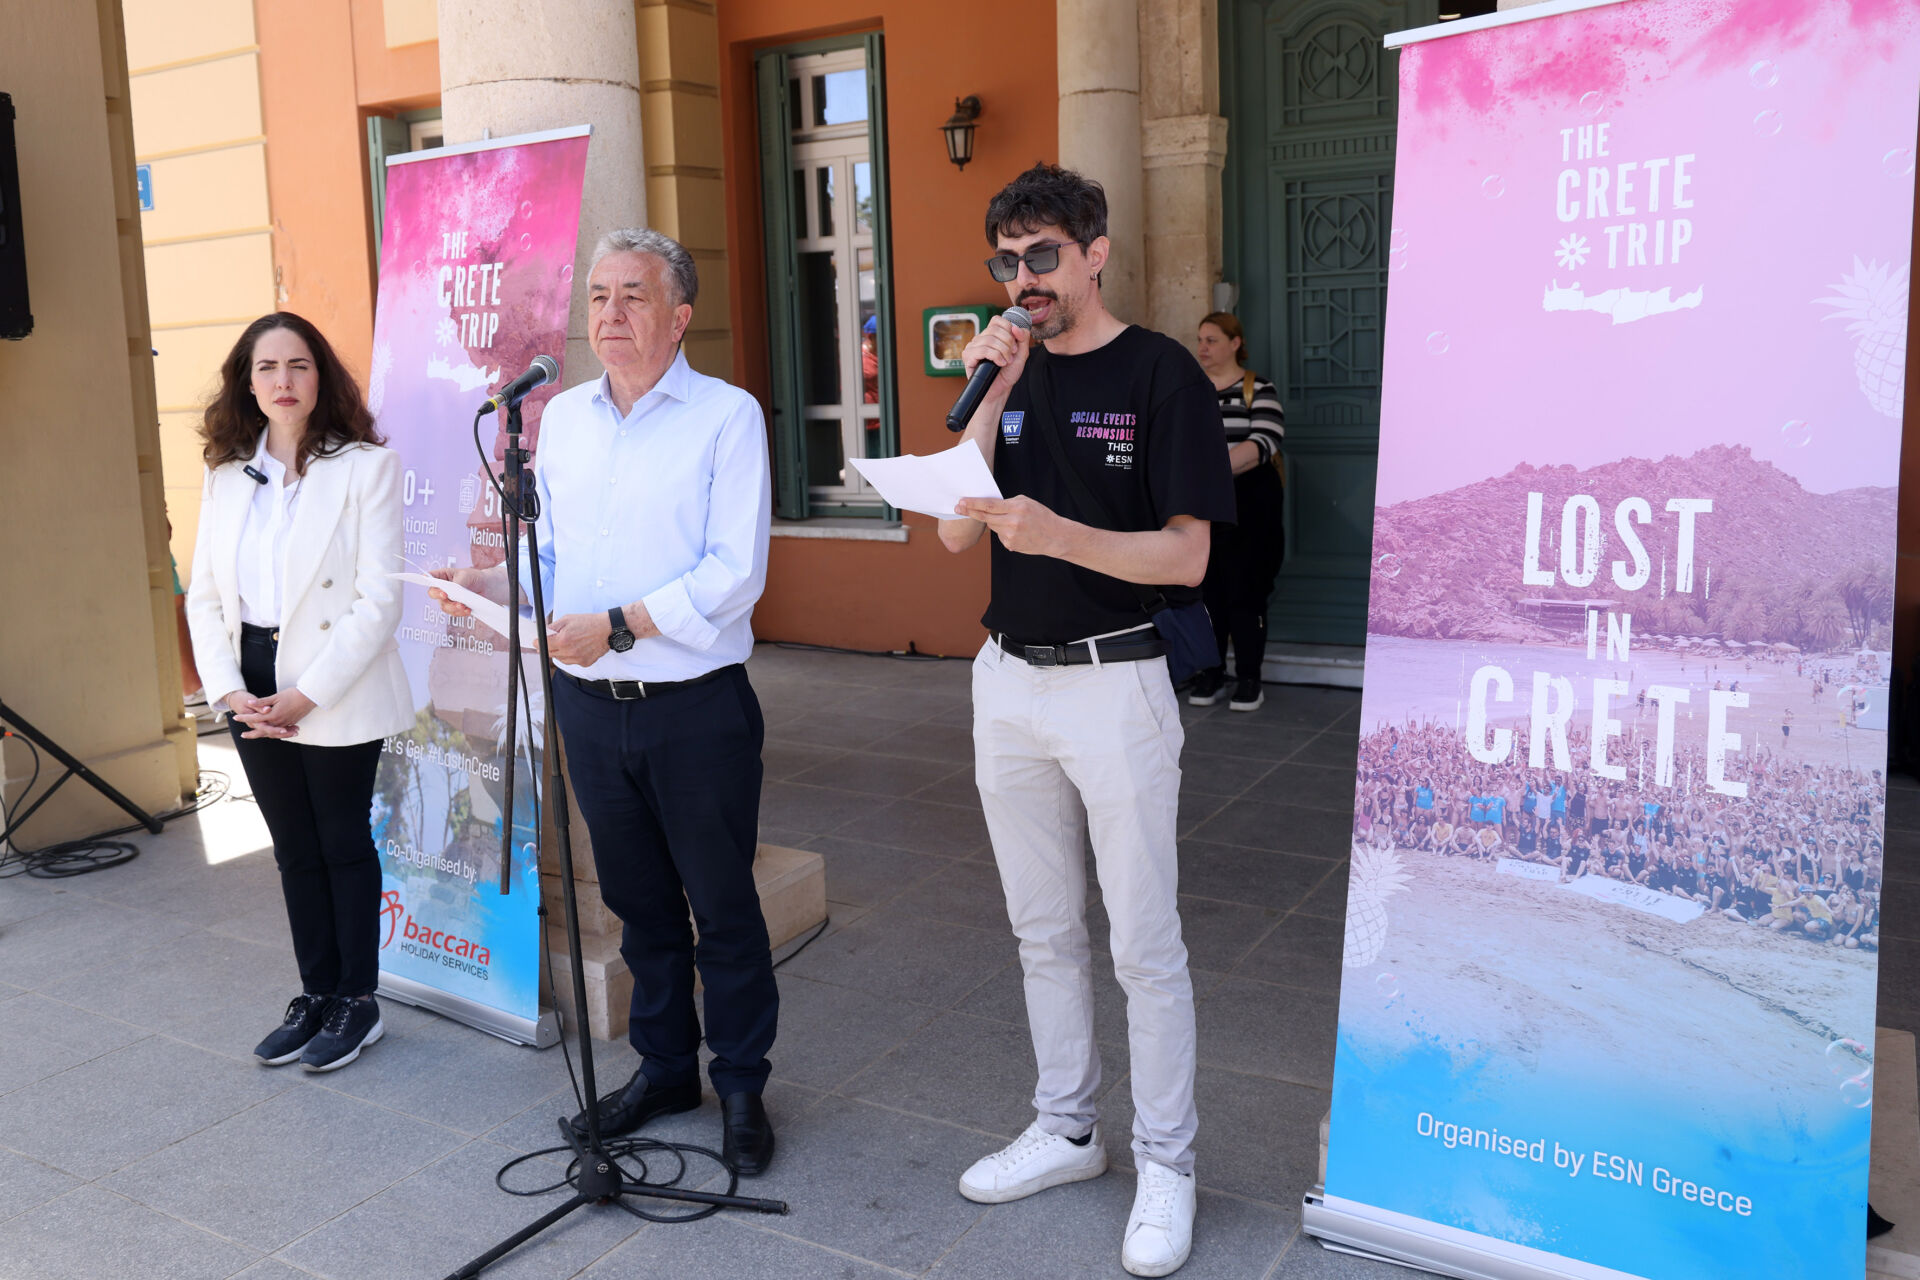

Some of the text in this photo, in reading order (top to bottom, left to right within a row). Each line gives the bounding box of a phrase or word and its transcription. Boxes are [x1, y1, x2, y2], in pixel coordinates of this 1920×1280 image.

[1560, 122, 1611, 162] THE
[1556, 153, 1696, 223] CRETE
[442, 231, 469, 259] THE
[1603, 218, 1693, 269] TRIP
[437, 262, 504, 308] CRETE
[461, 312, 500, 348] TRIP
[1070, 411, 1137, 426] SOCIAL EVENTS
[1076, 425, 1135, 441] RESPONSIBLE
[1107, 442, 1134, 452] THEO
[1115, 455, 1133, 464] ESN
[403, 469, 435, 506] 0+
[402, 514, 438, 535] tional
[1521, 491, 1714, 593] LOST
[423, 604, 446, 628] Days
[1586, 609, 1632, 663] IN
[401, 625, 494, 657] memories in Crete
[1465, 664, 1750, 798] CRETE
[380, 736, 500, 782] et's Get #LostInCrete
[386, 839, 478, 885] Co-Organised by:
[403, 914, 491, 966] baccara
[400, 941, 489, 981] HOLIDAY SERVICES
[1416, 1111, 1753, 1217] Organised by ESN Greece
